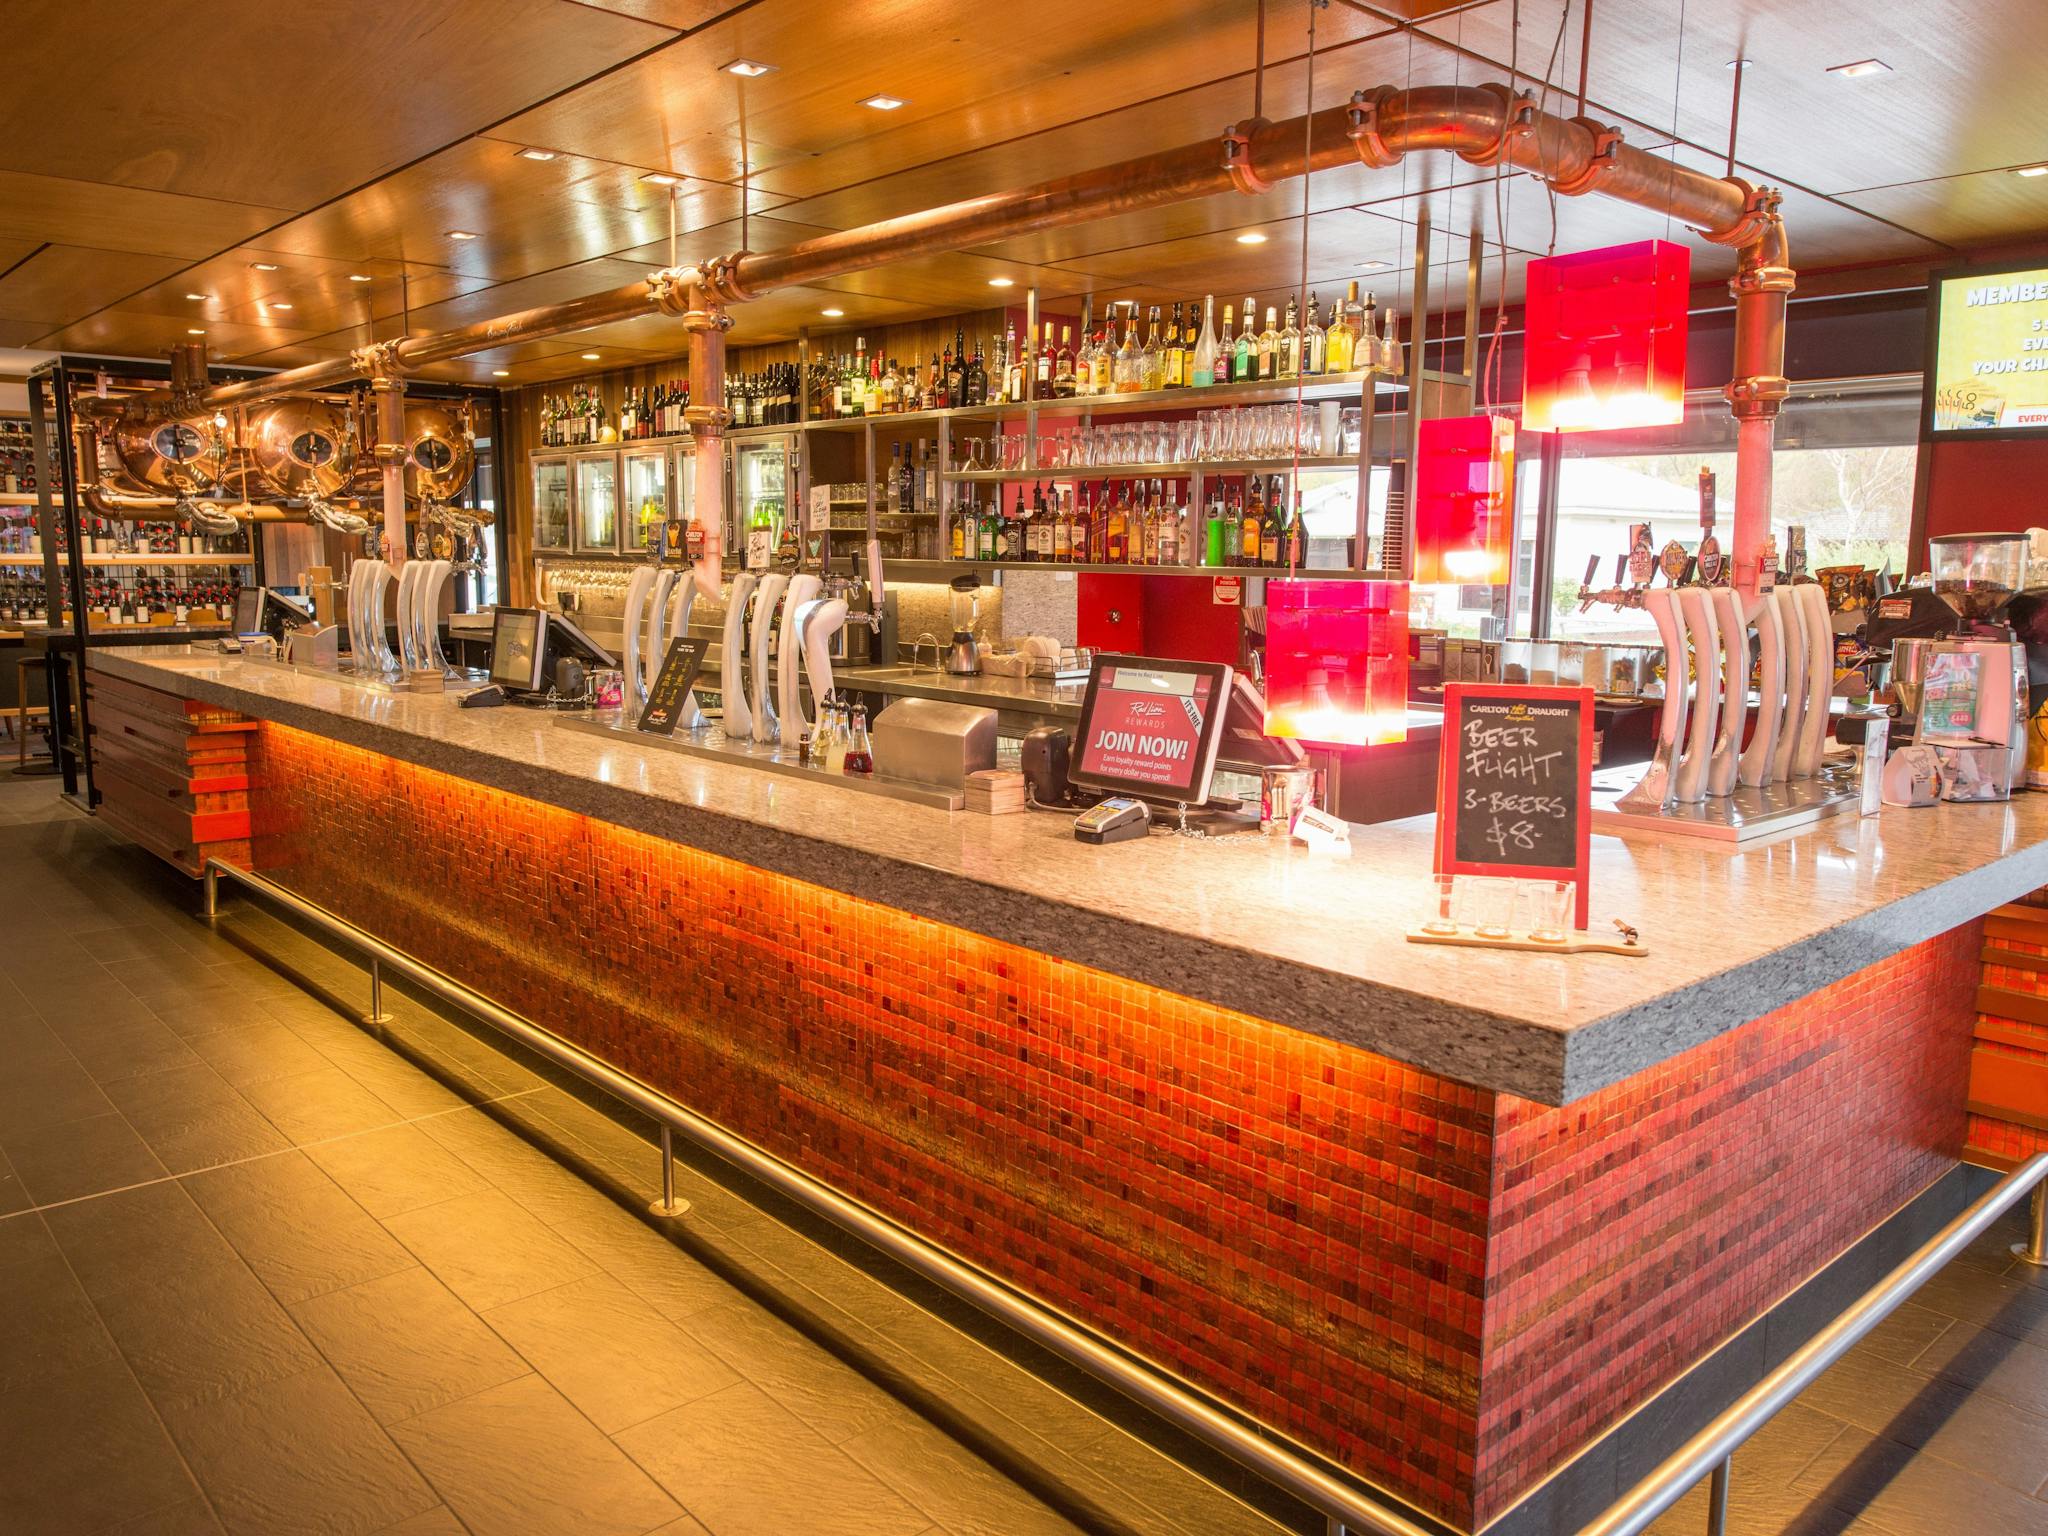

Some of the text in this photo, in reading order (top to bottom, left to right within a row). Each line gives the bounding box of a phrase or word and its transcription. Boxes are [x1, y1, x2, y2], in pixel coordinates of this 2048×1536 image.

[1973, 358, 2019, 376] YOUR
[1189, 710, 1201, 729] FREE
[1469, 704, 1570, 717] CARLTON DRAUGHT
[1124, 716, 1166, 729] REWARDS
[1463, 719, 1539, 748] BEER
[1094, 729, 1189, 761] JOIN NOW!
[1103, 753, 1172, 771] Earn loyalty reward points
[1108, 766, 1123, 776] every
[1123, 767, 1140, 777] dollar
[1140, 770, 1151, 780] you
